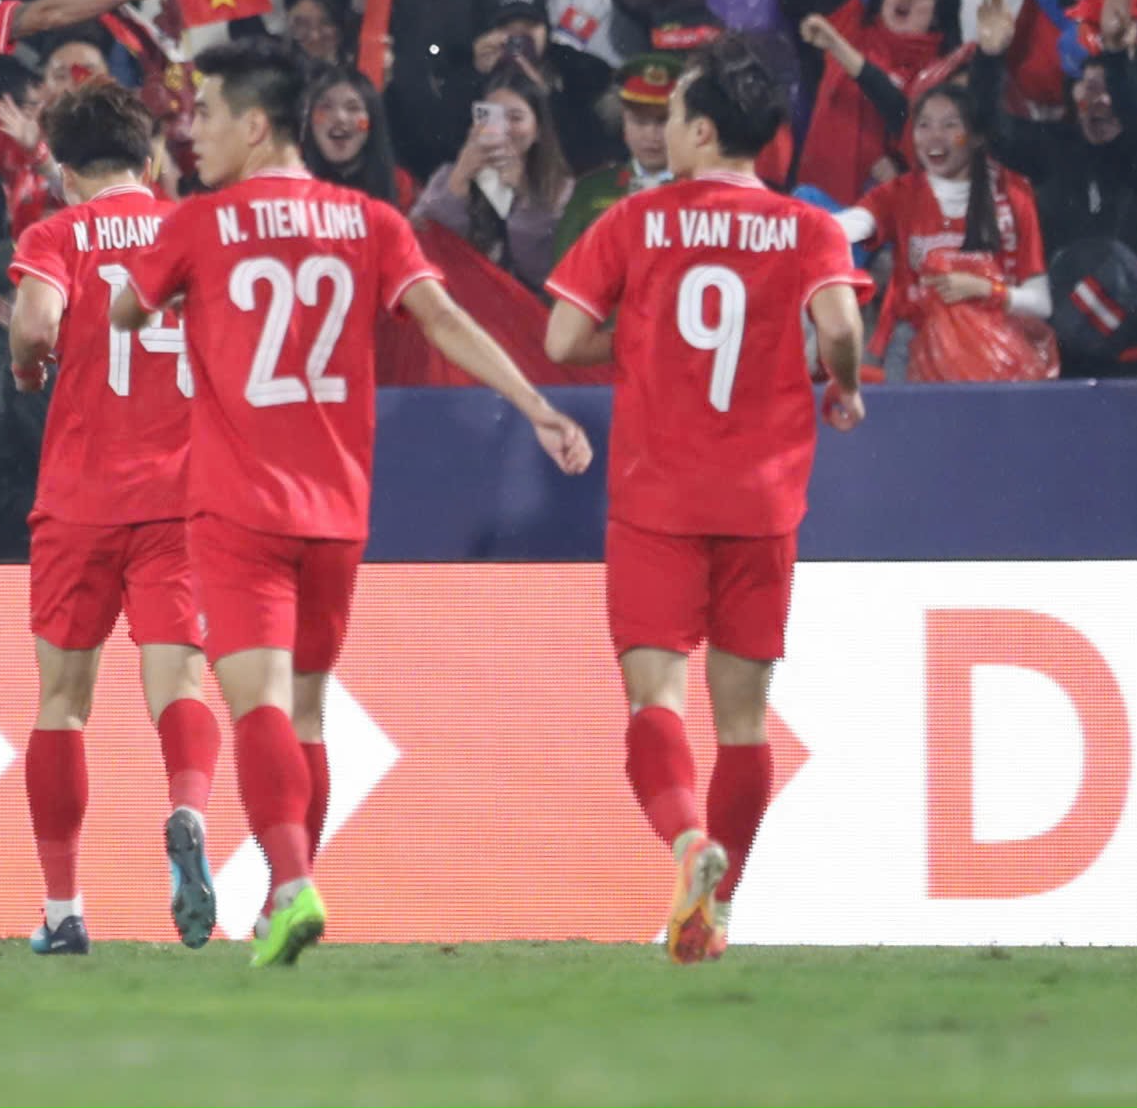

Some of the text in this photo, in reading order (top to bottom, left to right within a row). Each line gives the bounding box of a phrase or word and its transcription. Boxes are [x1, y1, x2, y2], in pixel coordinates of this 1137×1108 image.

[72, 220, 94, 252] N.
[216, 199, 367, 245] N. TIEN LINH
[644, 208, 797, 253] N. VAN TOAN
[97, 263, 196, 399] 14
[228, 254, 355, 408] 22
[676, 263, 746, 413] 9
[923, 607, 1133, 900] D
